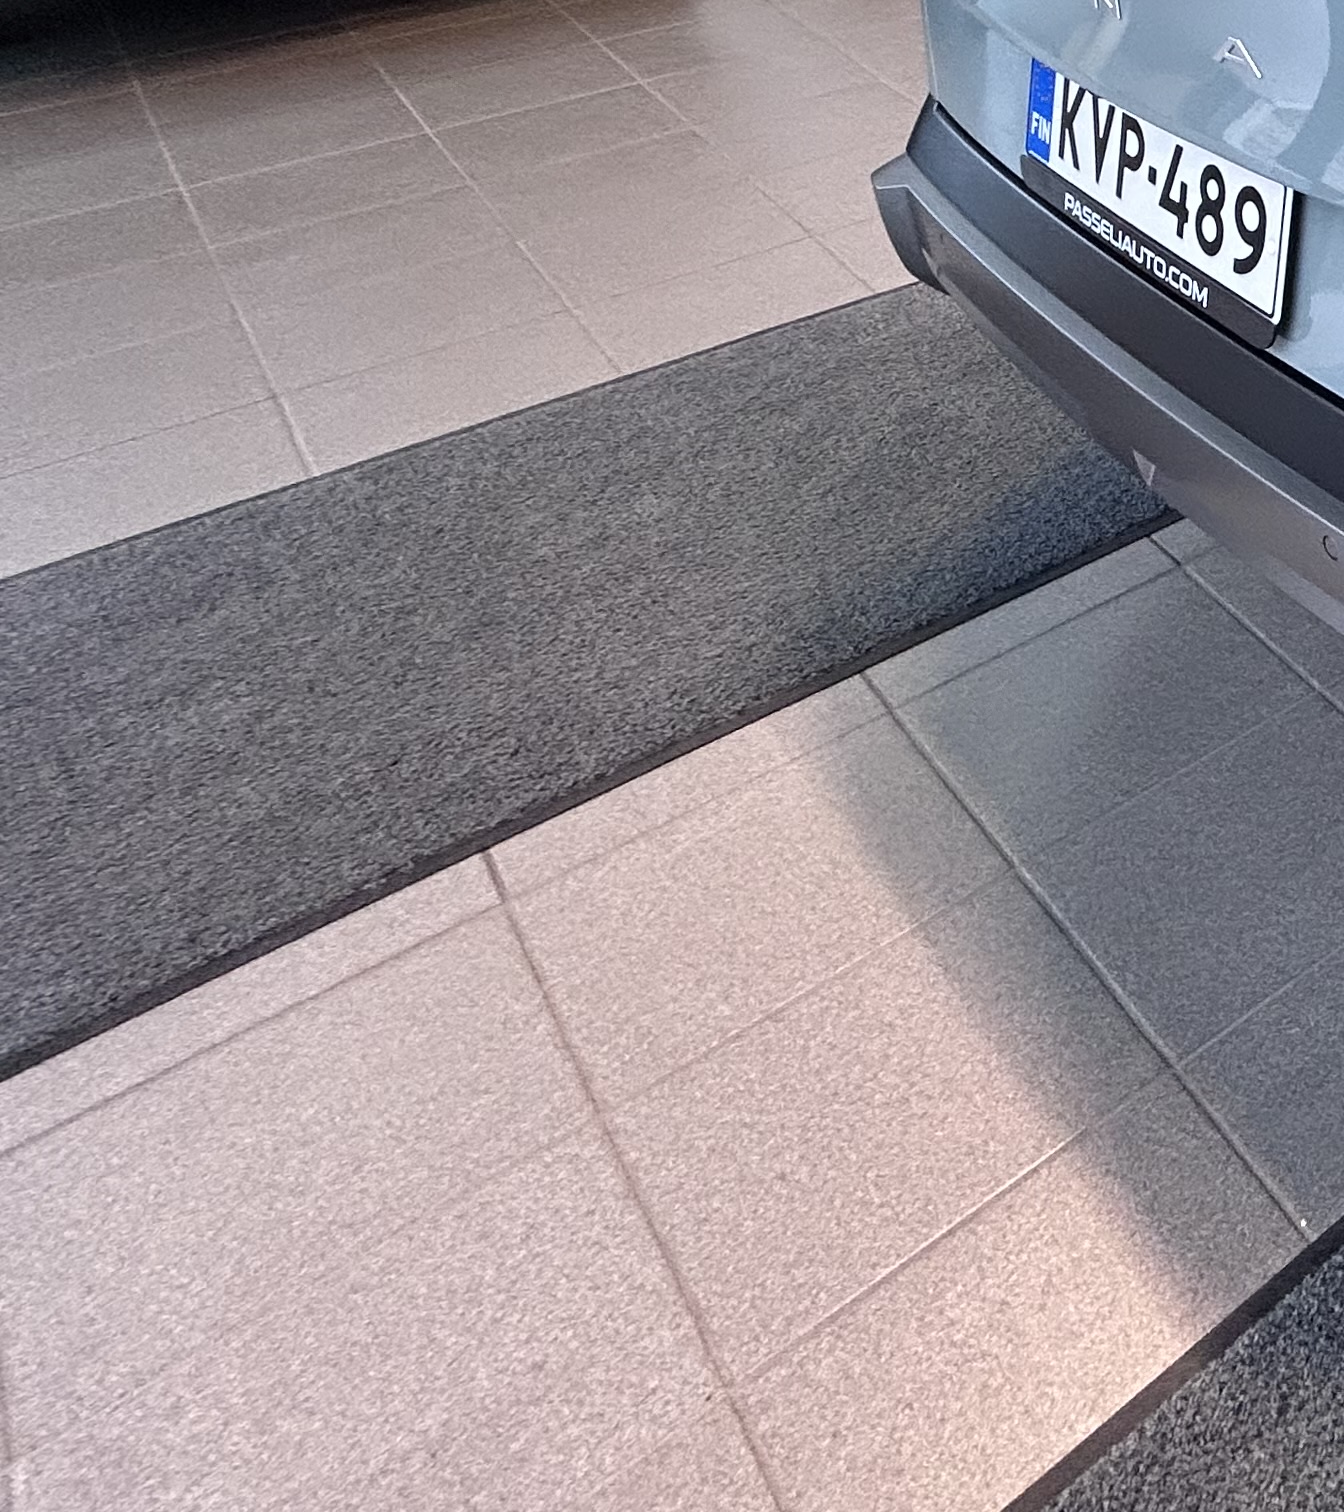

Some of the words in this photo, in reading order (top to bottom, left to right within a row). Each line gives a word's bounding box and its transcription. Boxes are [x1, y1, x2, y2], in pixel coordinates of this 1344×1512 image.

[1031, 111, 1051, 144] FIN
[1058, 78, 1267, 275] KVP-489
[1064, 192, 1209, 308] PASSELIAUTO.COM
